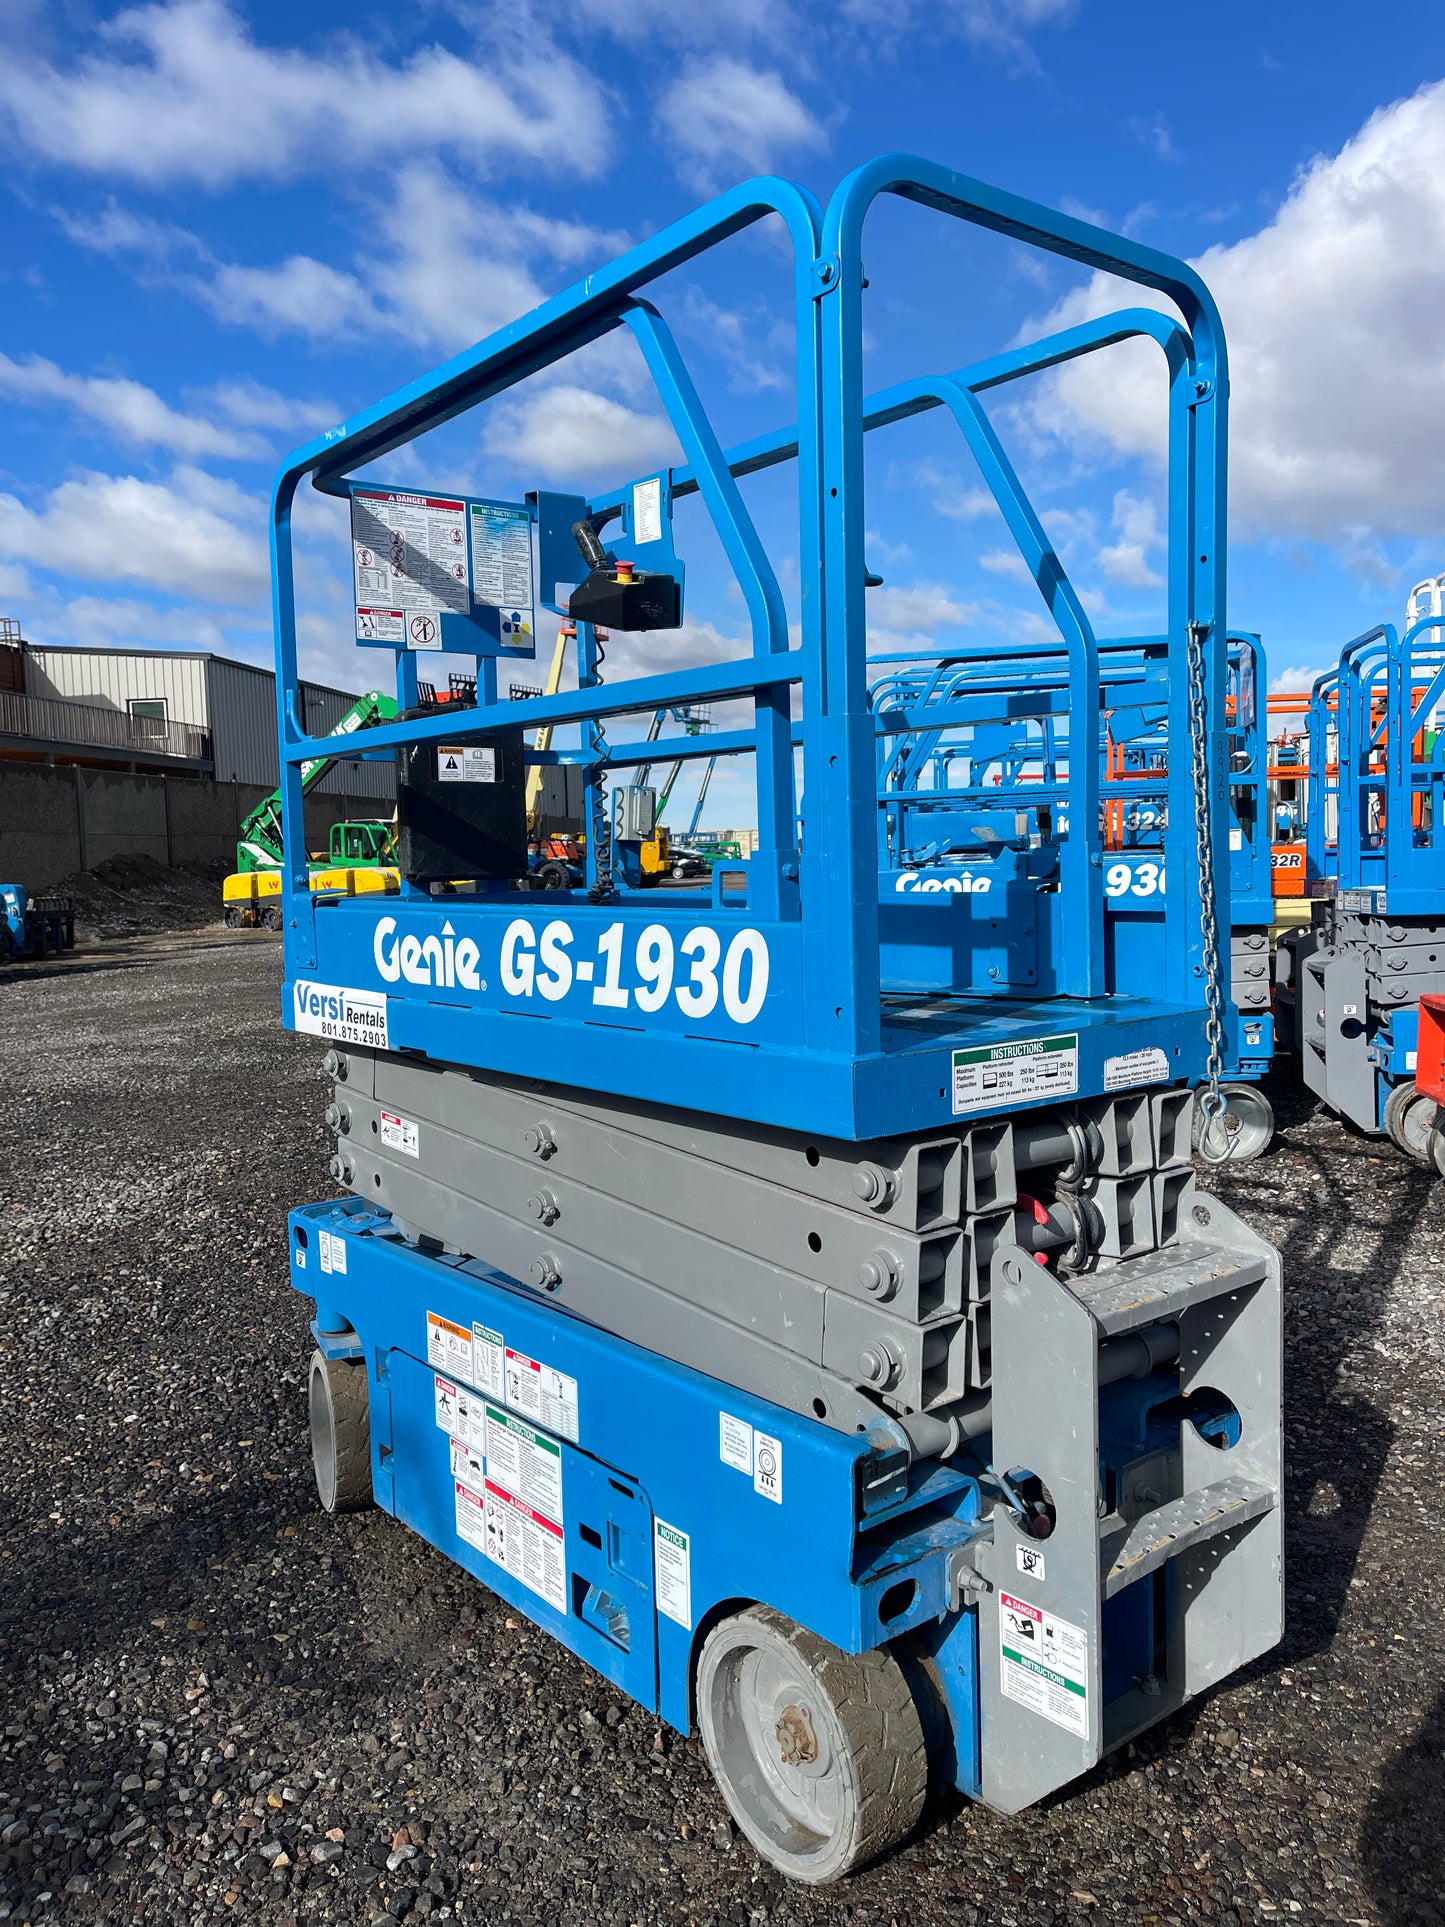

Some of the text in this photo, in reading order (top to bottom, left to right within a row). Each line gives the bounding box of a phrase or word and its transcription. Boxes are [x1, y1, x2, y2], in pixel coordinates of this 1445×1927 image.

[396, 495, 427, 506] DANGER
[481, 507, 520, 519] INSTRUCTIONS
[1105, 864, 1166, 897] 93
[373, 916, 770, 1024] Genie GS-1930
[346, 1006, 385, 1029] Rentals
[321, 1021, 387, 1047] 801.875.2903
[990, 1041, 1044, 1060] INSTRUCTIONS
[506, 1418, 537, 1443] INSTRUCTIONS
[514, 1499, 533, 1519] DANGER
[661, 1526, 684, 1549] NOTICE
[1012, 1600, 1036, 1620] DANGER
[1021, 1656, 1065, 1687] INSTRUCTIONS
